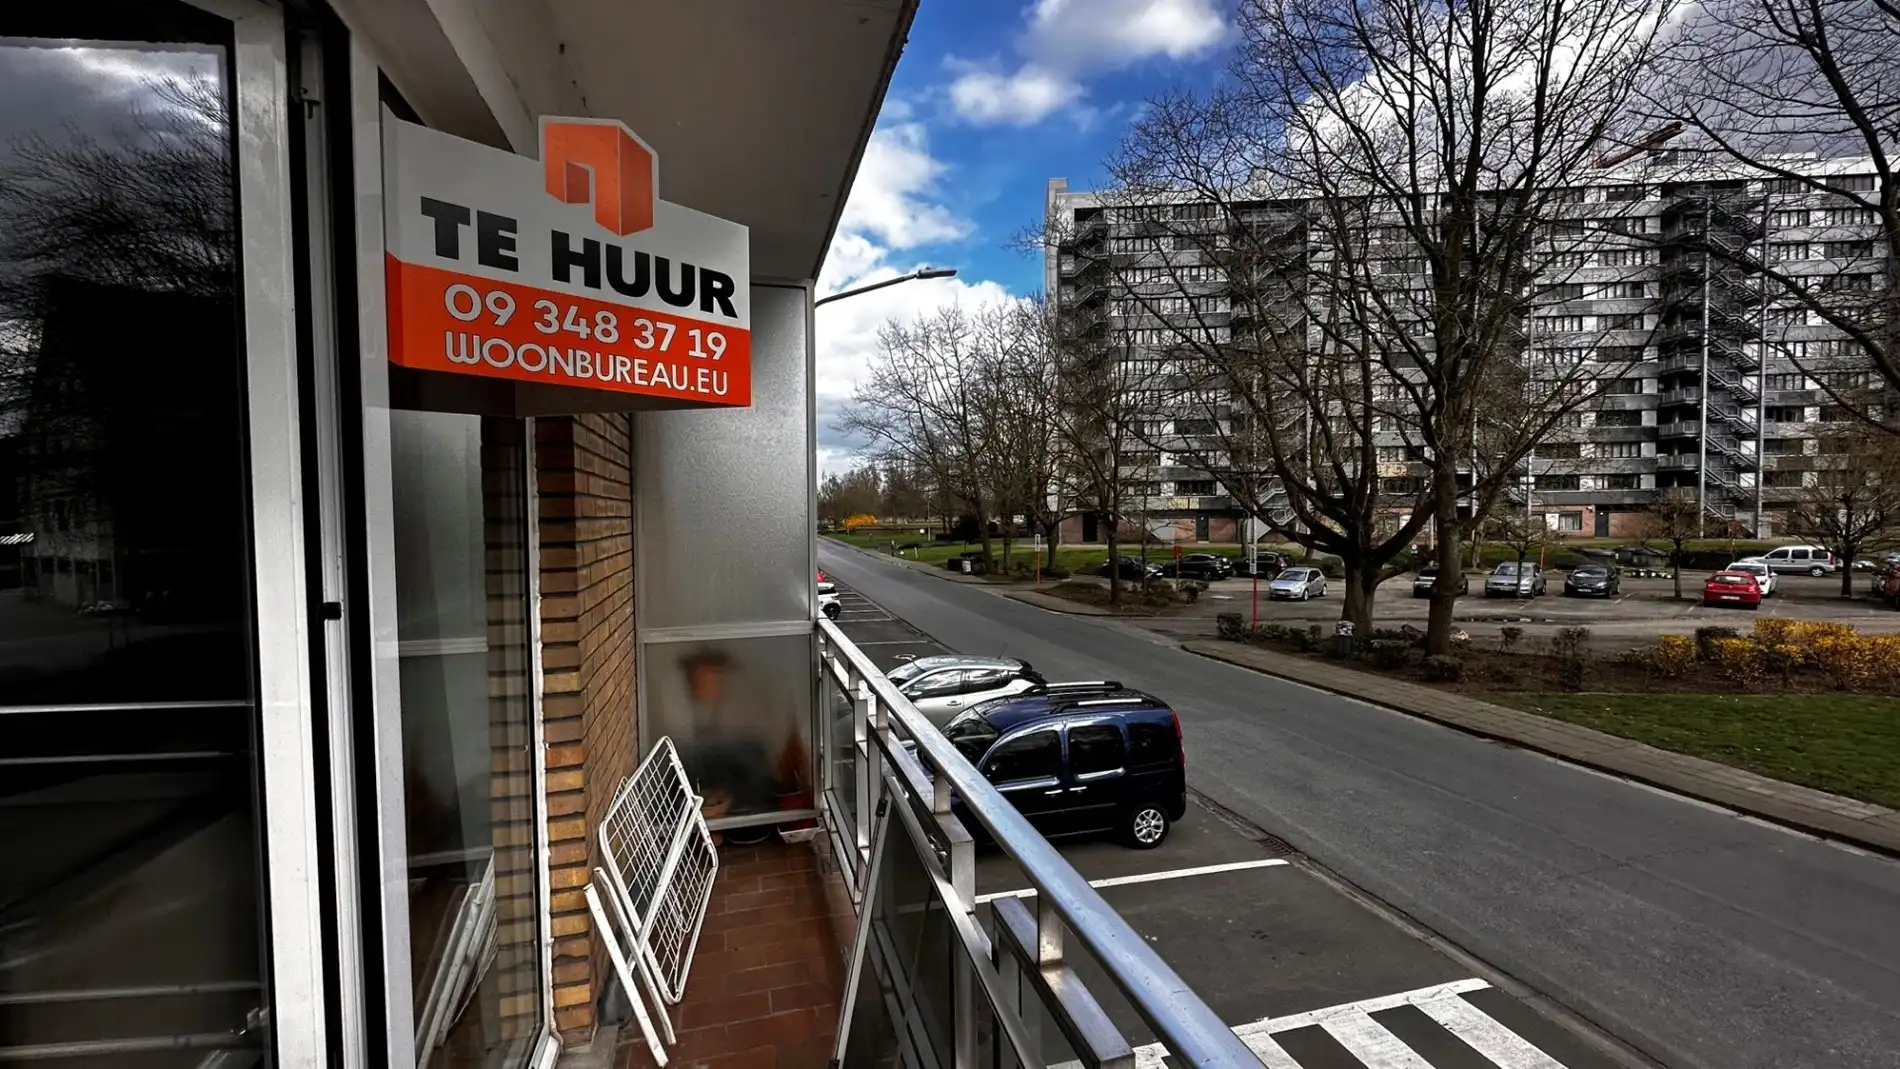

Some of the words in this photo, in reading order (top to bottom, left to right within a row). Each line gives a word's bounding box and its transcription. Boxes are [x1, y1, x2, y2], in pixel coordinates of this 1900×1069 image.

[420, 196, 519, 272] TE
[551, 229, 738, 318] HUUR
[444, 283, 516, 326] 09
[533, 299, 619, 343] 348
[633, 317, 676, 351] 37
[688, 328, 727, 360] 19
[445, 330, 728, 395] WOONBUREAU.EU
